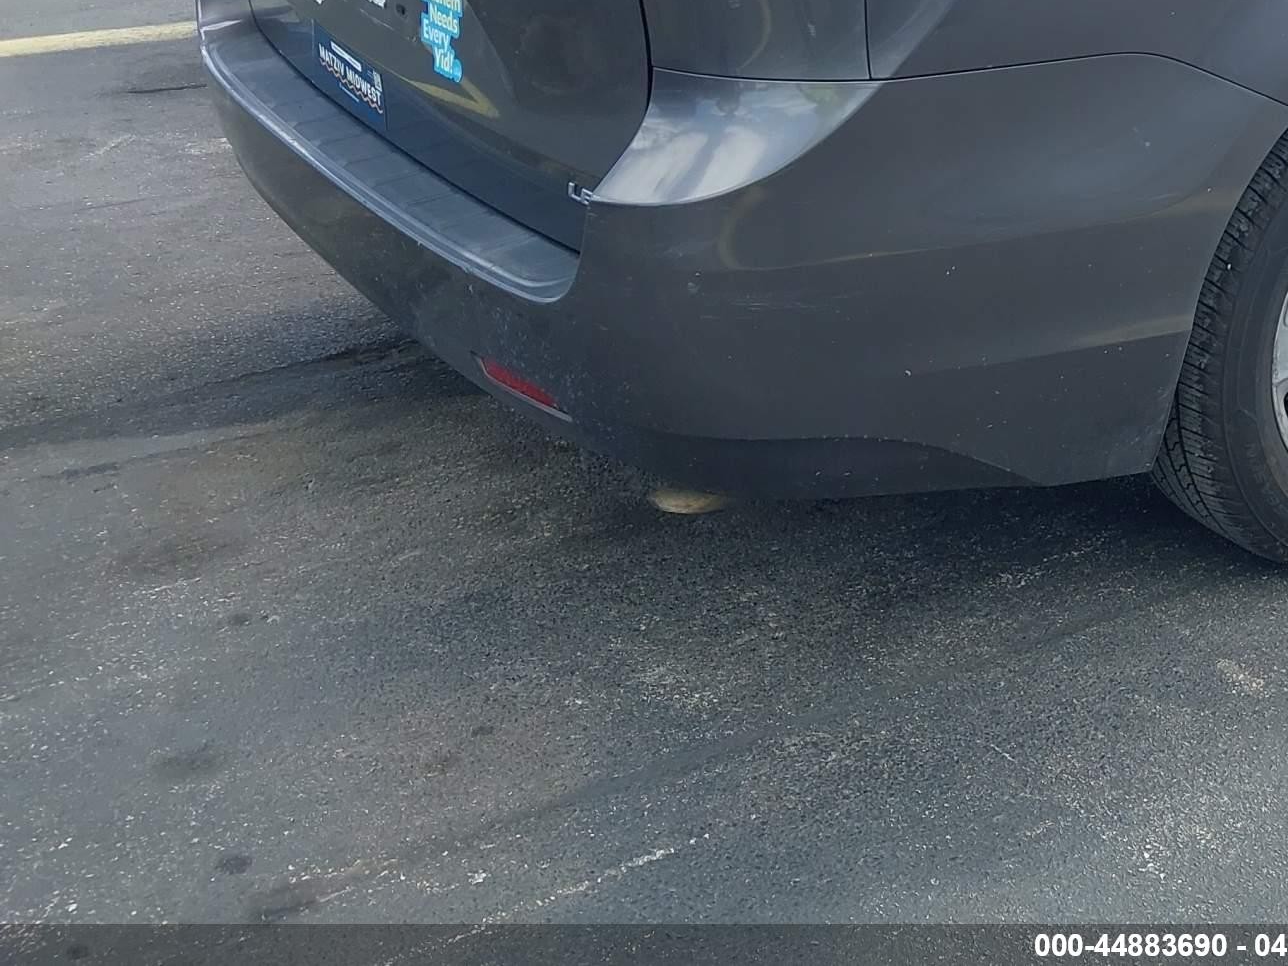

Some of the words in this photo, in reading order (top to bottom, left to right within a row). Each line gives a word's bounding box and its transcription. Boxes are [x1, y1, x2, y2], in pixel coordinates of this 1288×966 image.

[429, 1, 458, 34] Needs
[423, 19, 450, 52] Every
[433, 45, 454, 75] Yid!
[346, 65, 381, 106] MIDWEST
